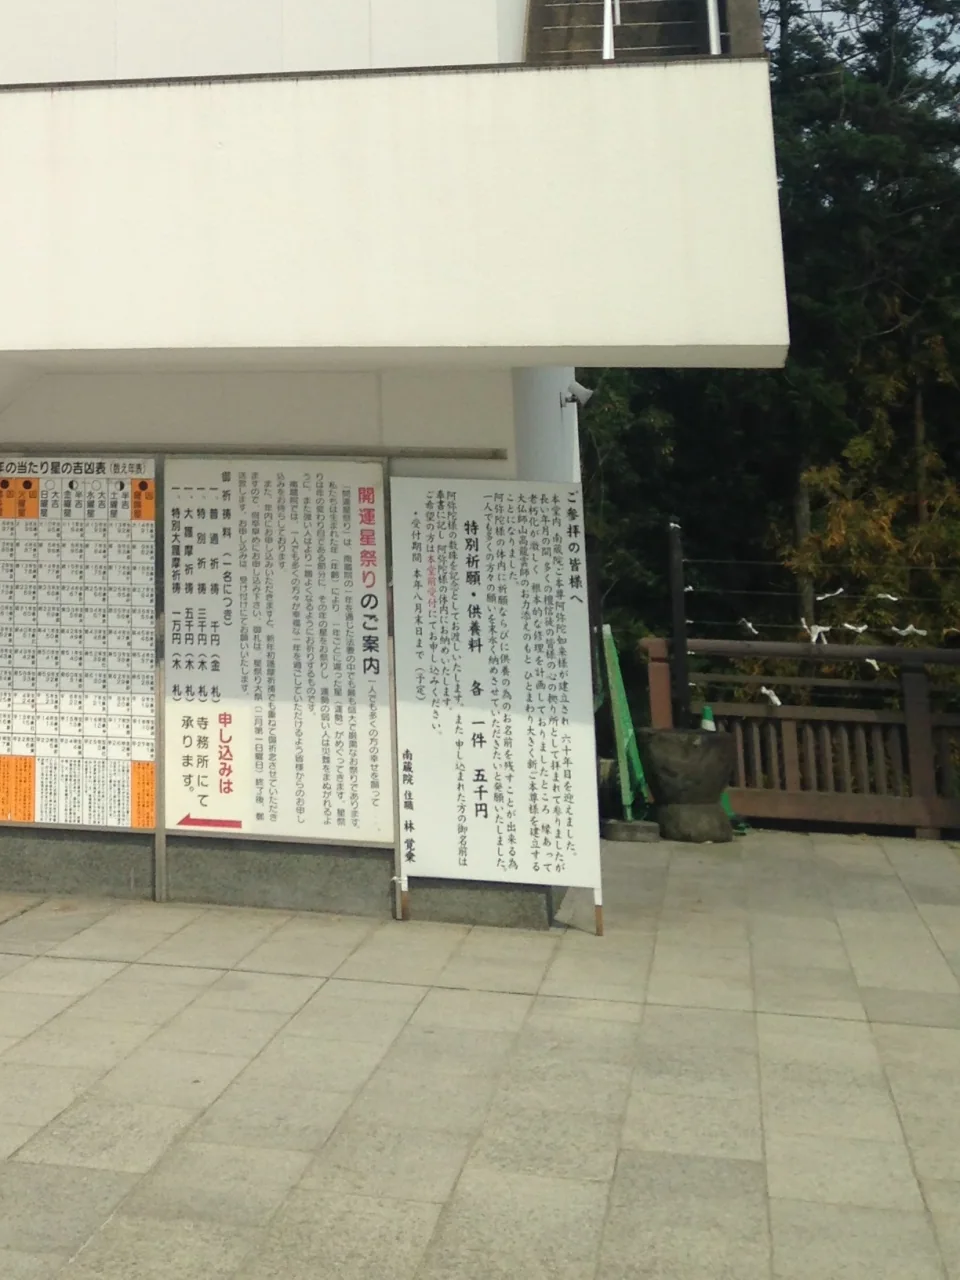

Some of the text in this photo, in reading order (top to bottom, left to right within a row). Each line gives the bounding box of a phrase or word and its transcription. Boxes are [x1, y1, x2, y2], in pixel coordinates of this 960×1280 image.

[51, 491, 59, 508] 大吉
[98, 491, 106, 509] 大吉
[540, 494, 552, 557] 長い年月の間
[506, 494, 519, 586] ことになりました。
[567, 490, 583, 604] ご参拝の皆様へ
[358, 487, 380, 676] 開運星祭りのご案内
[412, 567, 425, 660] 本年八月末日まで
[172, 611, 182, 645] 一万円
[185, 607, 194, 645] 五千円
[197, 608, 207, 646] 三千円
[210, 620, 220, 646] 千円
[415, 667, 426, 701] （予定）
[464, 519, 488, 819] 特別祈願・供養料 各 一件 五千円
[528, 494, 553, 872] 老朽化が激しく 根本的な修理を計画しておりましたところ 縁あって
[552, 494, 561, 528] 本堂内
[561, 734, 578, 856] 六十年目を迎えました。
[181, 715, 195, 792] 承ります。
[196, 716, 209, 808] 寺務所にて
[218, 712, 233, 794] 申し込みは
[402, 748, 414, 785] 南蔵院
[524, 671, 541, 872] ひとまわり大きく新ご本尊様を建立する
[403, 789, 414, 810] 住職
[404, 820, 415, 832] 林
